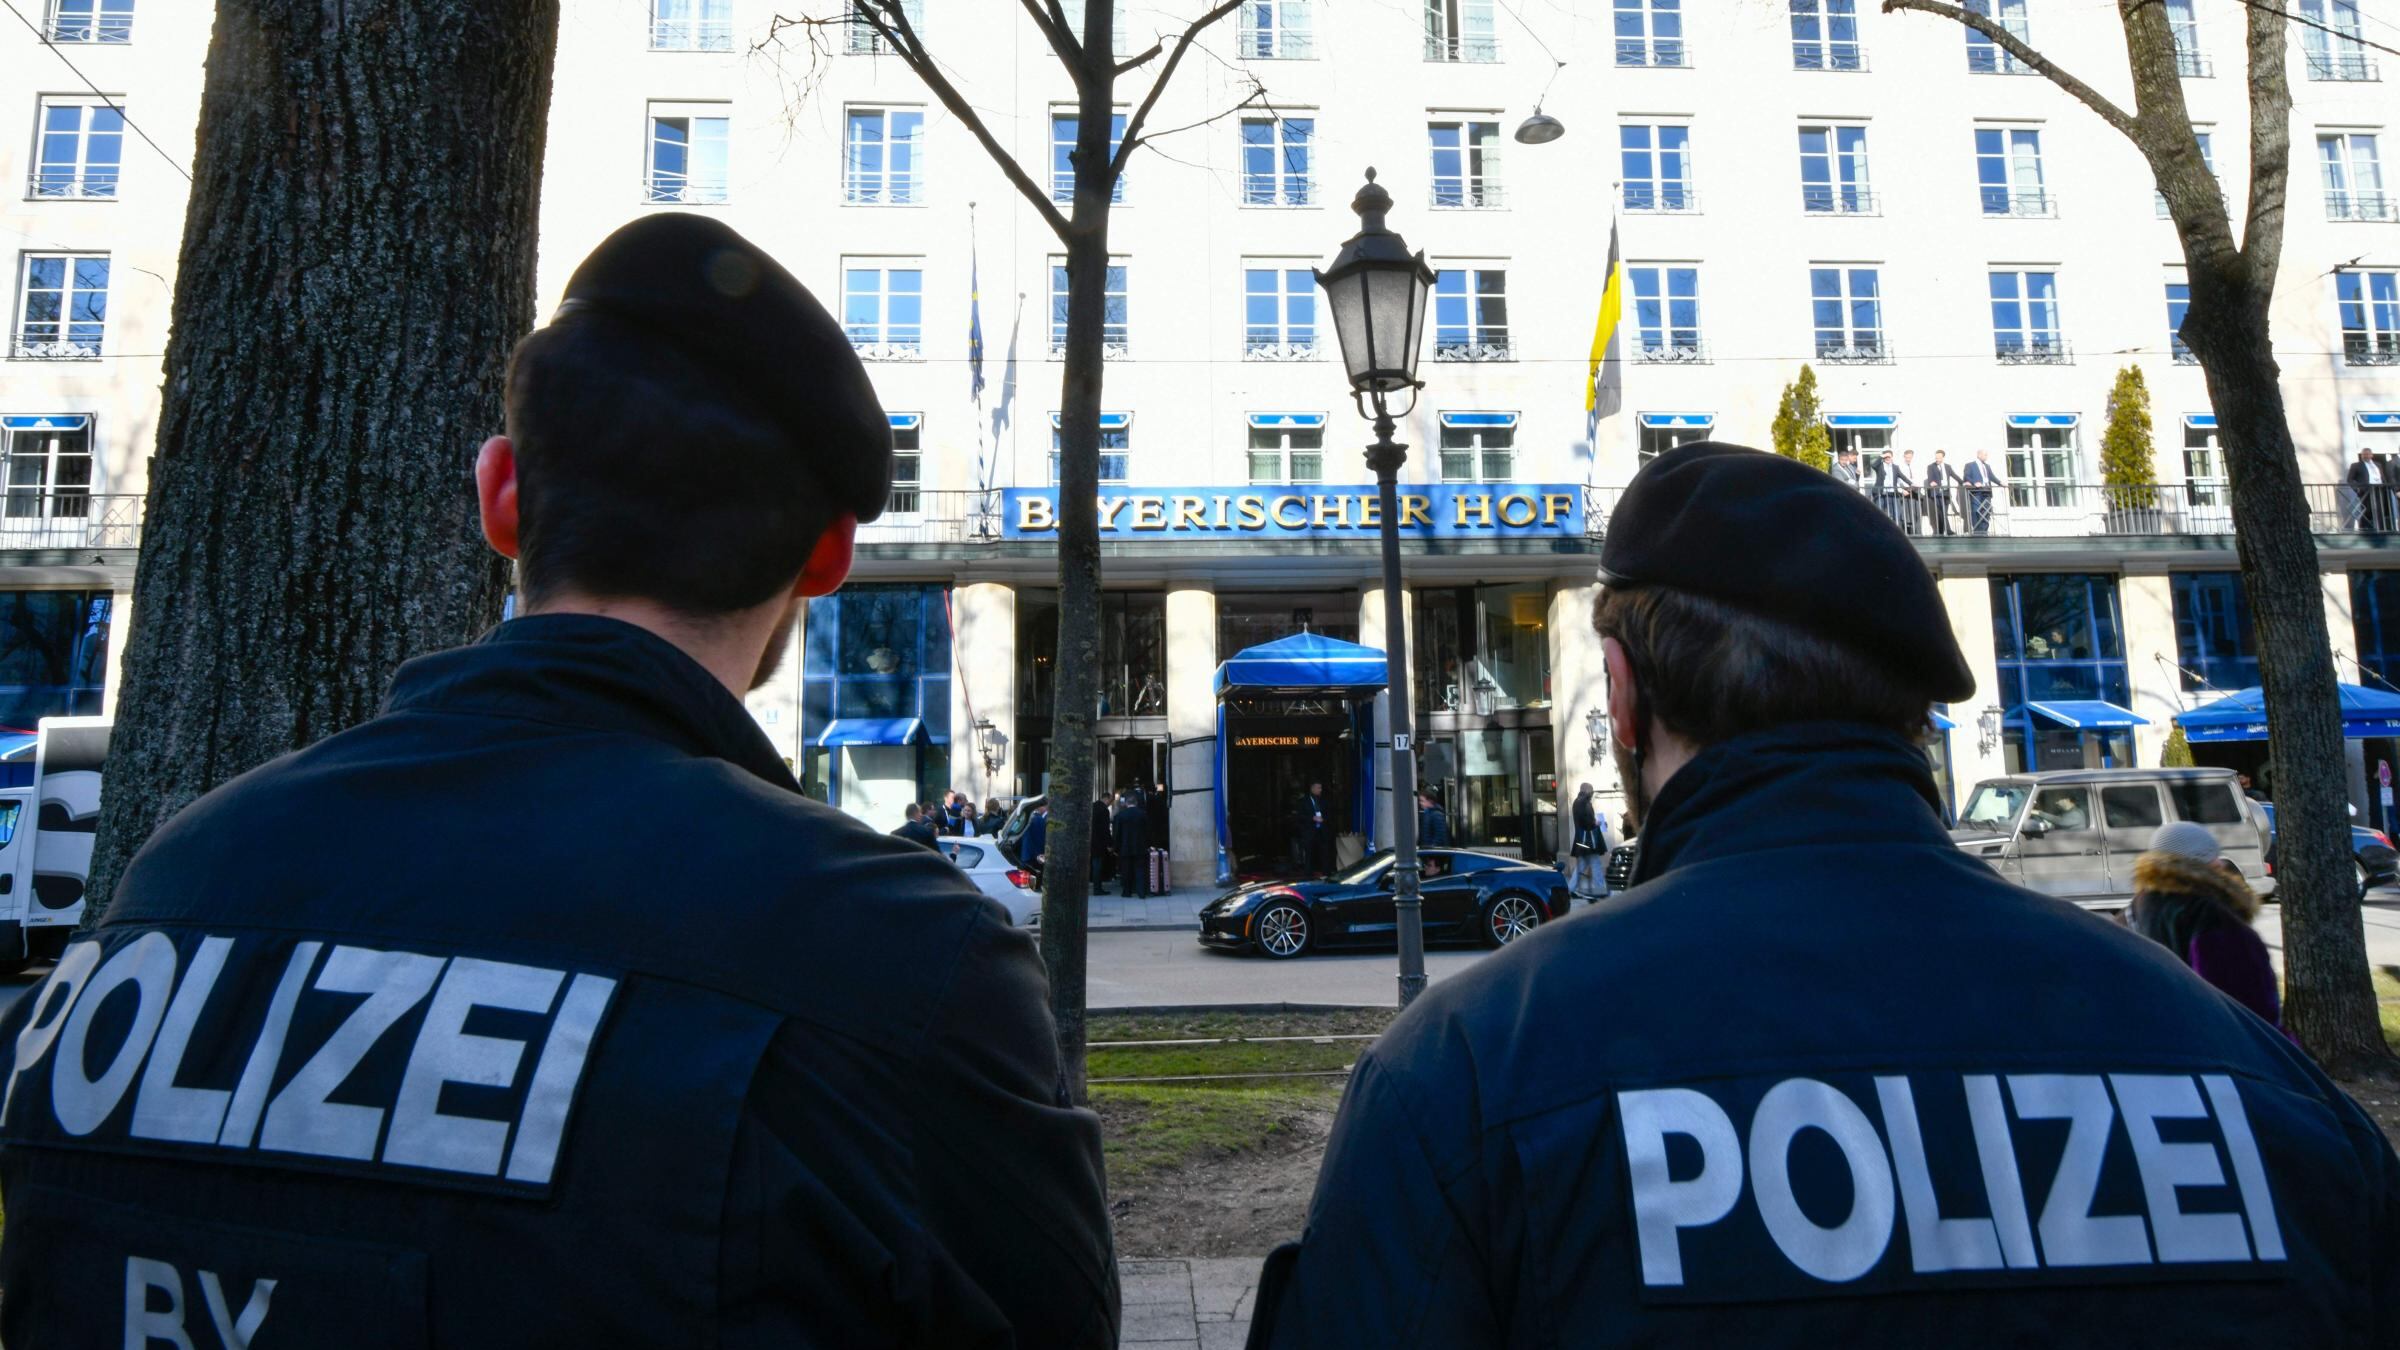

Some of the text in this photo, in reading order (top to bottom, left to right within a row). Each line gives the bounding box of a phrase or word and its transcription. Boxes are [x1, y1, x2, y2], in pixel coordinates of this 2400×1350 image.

[1015, 493, 1574, 531] BYERISCHER HOF
[1235, 735, 1320, 746] BAYERISCHER HOF
[1396, 736, 1409, 748] 17
[0, 931, 618, 1184] POLIZEI
[1616, 1073, 2288, 1286] POLIZEI
[124, 1255, 279, 1350] BY
